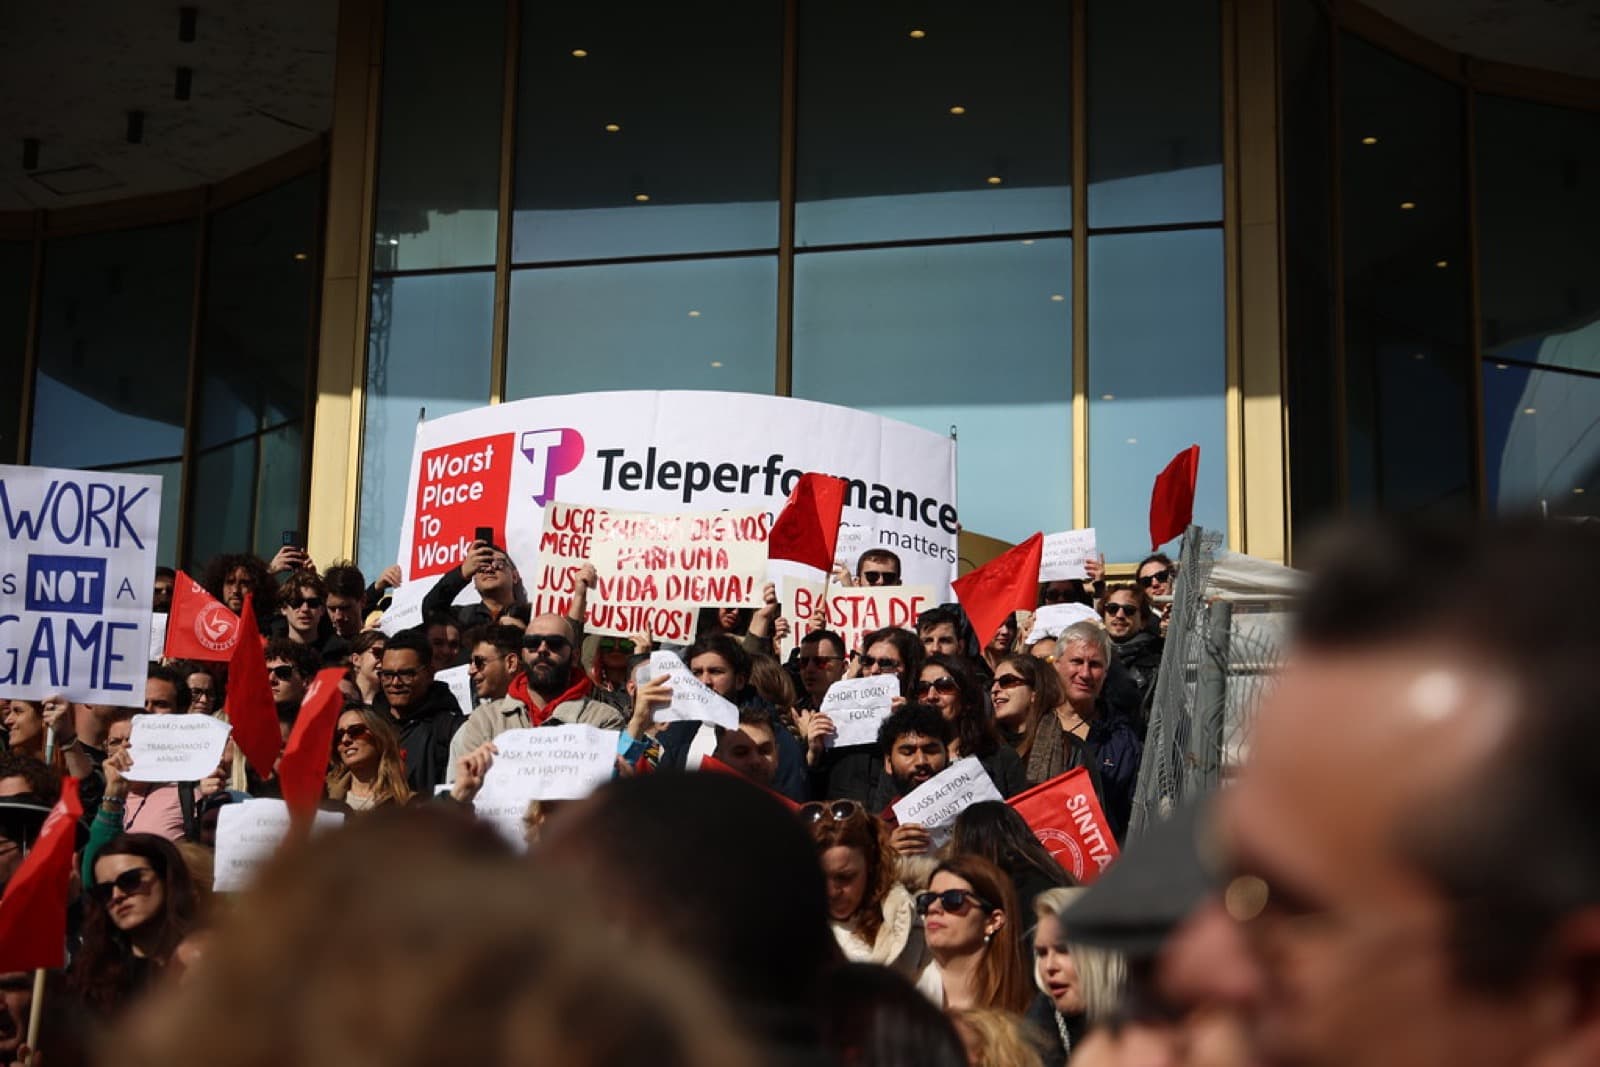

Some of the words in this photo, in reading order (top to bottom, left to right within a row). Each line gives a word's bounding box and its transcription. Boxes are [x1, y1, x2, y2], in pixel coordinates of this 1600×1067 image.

[428, 444, 494, 481] Worst
[422, 481, 484, 511] Place
[597, 446, 958, 535] Teleperfomance
[0, 479, 149, 550] WORK
[420, 515, 442, 539] To
[418, 536, 471, 569] Work
[539, 532, 592, 559] MERE
[680, 546, 729, 571] UMA
[880, 528, 956, 564] matters
[2, 573, 17, 595] S
[34, 570, 99, 604] NOT
[116, 577, 136, 600] A
[537, 564, 581, 594] JUS
[600, 575, 658, 602] VIDA
[666, 575, 753, 603] DIGNA!
[794, 588, 880, 628] BASTA
[888, 596, 925, 628] DE
[0, 615, 138, 691] GAME
[828, 690, 857, 702] SHORT
[849, 708, 876, 720] FOME
[502, 750, 523, 760] ASK
[525, 750, 543, 760] ME
[547, 750, 586, 760] TODAY
[529, 736, 558, 745] DEAR
[908, 794, 935, 818] CLASS
[935, 773, 971, 799] ACTION
[921, 800, 961, 828] AGAINST
[961, 791, 975, 804] TP
